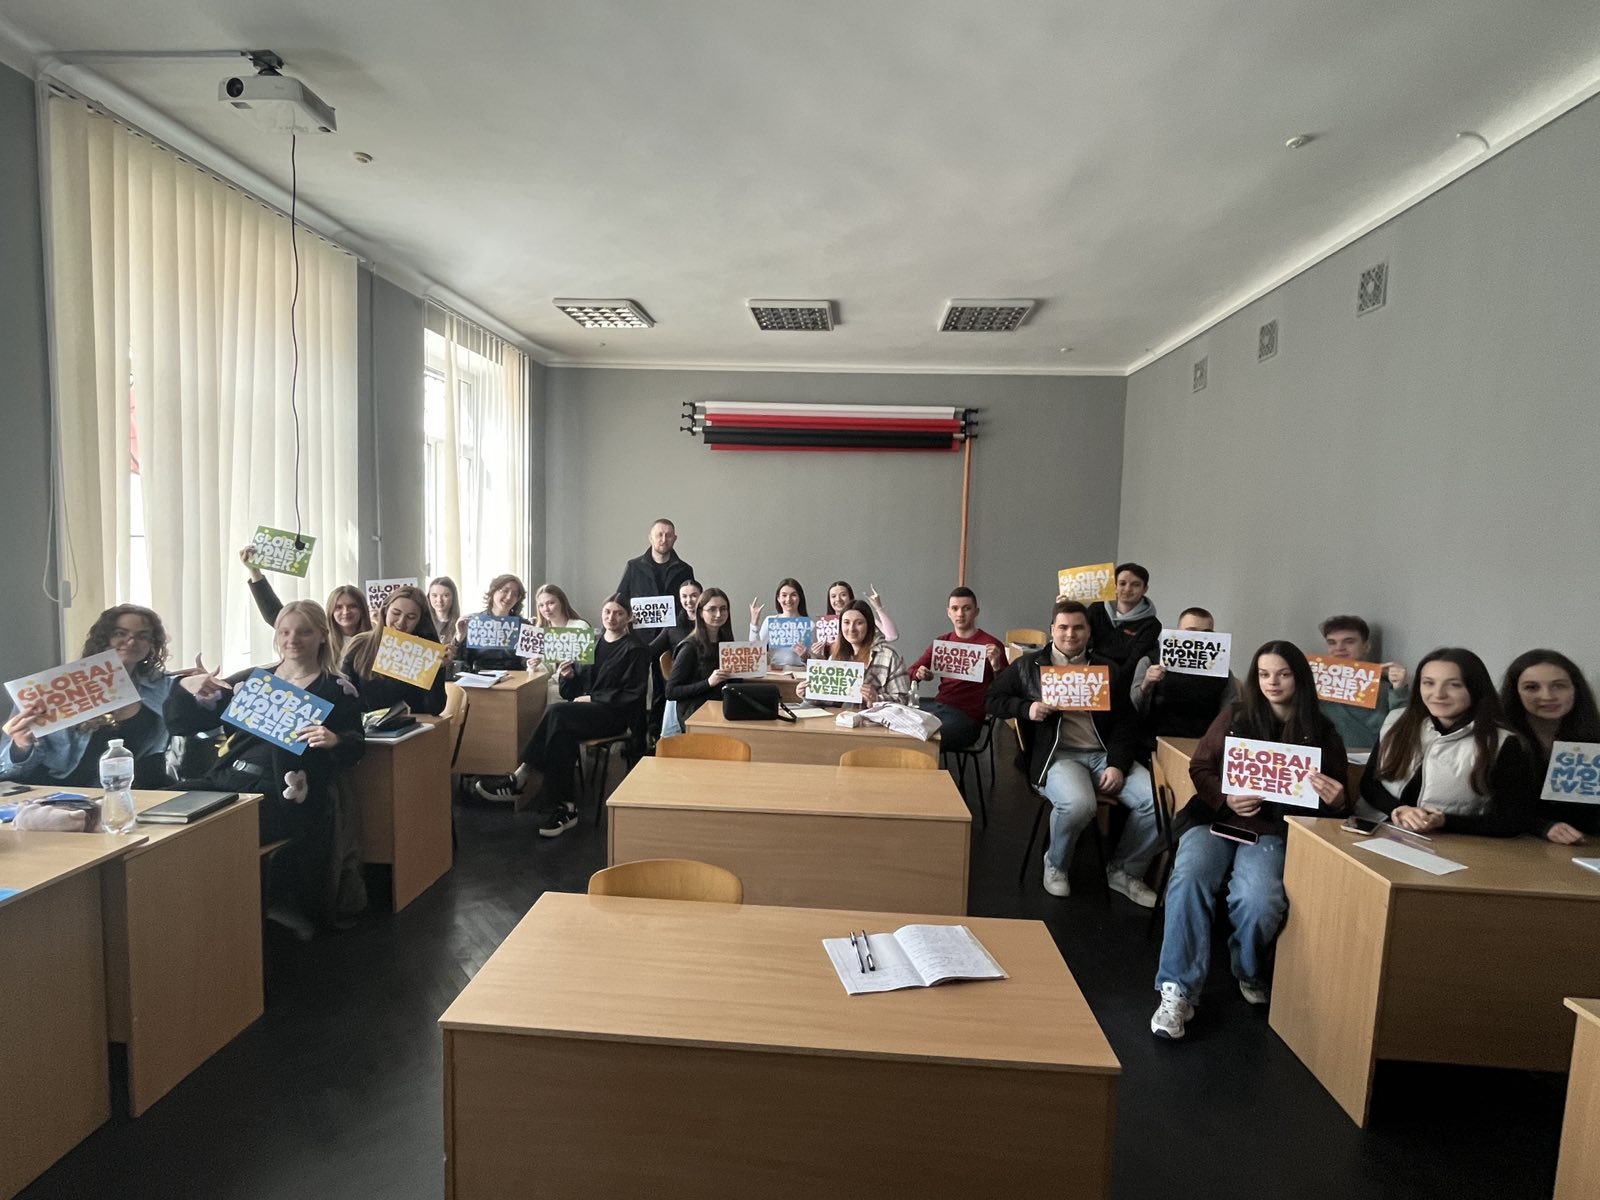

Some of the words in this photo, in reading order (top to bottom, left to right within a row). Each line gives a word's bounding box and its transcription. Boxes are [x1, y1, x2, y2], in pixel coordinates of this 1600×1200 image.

[255, 532, 312, 554] GLOBL
[1059, 570, 1114, 585] GLOBAL
[1060, 580, 1109, 593] MONEY
[633, 603, 672, 612] GLOBAL
[632, 610, 668, 619] MONEY
[633, 616, 663, 625] WEEK
[468, 620, 518, 630] GLOBAL
[769, 621, 814, 632] GLOBAL
[467, 629, 513, 640] MONEY
[545, 632, 594, 643] GLOBAL
[769, 630, 806, 639] MONEY
[382, 634, 442, 660] GLOBAL
[467, 638, 505, 647] WEEK
[544, 641, 590, 652] MONEY
[769, 637, 801, 646] WEEK
[1162, 638, 1226, 653] GLOBAL
[545, 651, 580, 661] WEEK
[721, 646, 766, 656] GLOBAL
[934, 646, 984, 660] GLOBAL
[1162, 648, 1218, 661] MONEY
[379, 646, 435, 672] MONEY
[721, 655, 761, 666] MONEY
[934, 655, 979, 668] MONEY
[1162, 657, 1208, 670] WEEK
[376, 657, 418, 681] WEEK
[809, 665, 862, 679] GLOBAL
[933, 661, 969, 675] WEEK
[1307, 661, 1379, 682] GLOBAL
[17, 661, 122, 701] GLOBAL
[808, 675, 858, 688] MONEY
[1041, 672, 1109, 685] GLOBAL
[808, 684, 848, 696] WEEK
[1042, 684, 1103, 697] MONEY
[1316, 684, 1357, 701] EEK
[245, 677, 323, 725] GLOBAL
[1041, 694, 1092, 707] WEEK
[234, 689, 311, 733] MONEY
[228, 702, 292, 743] WEEK
[1228, 746, 1318, 771] GLOBAL
[1227, 760, 1309, 783] MONEY
[1227, 773, 1293, 796] WEEK
